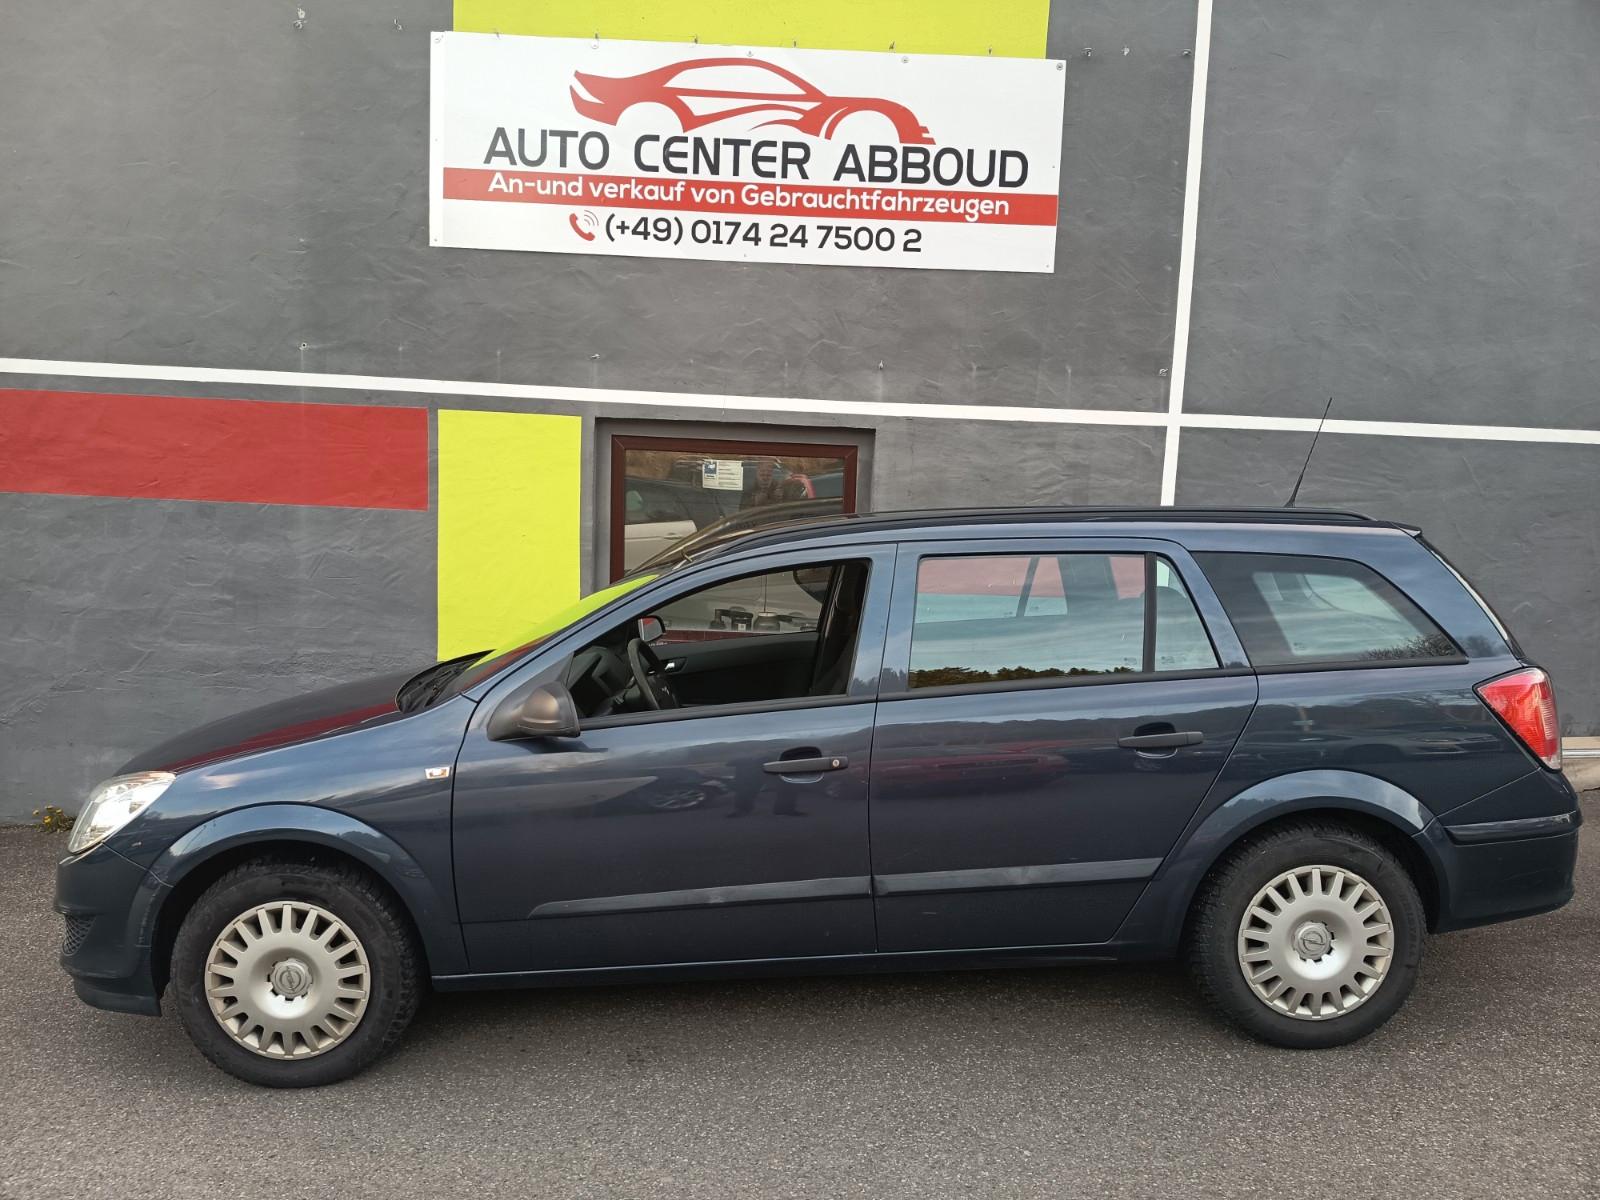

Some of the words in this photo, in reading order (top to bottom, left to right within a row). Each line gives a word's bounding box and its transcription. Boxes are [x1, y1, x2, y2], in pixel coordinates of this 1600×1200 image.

[484, 127, 610, 170] AUTO
[634, 134, 811, 180] CENTER
[833, 143, 1029, 188] ABBOUD
[488, 172, 583, 197] An-und
[589, 179, 686, 202] verkauf
[691, 187, 735, 205] von
[741, 183, 1009, 222] Gebrauchtfahrzeugen
[605, 213, 684, 246] (+49)
[691, 219, 762, 247] 0174
[769, 223, 809, 248] 24
[816, 225, 896, 252] 7500
[902, 228, 922, 253] 2
